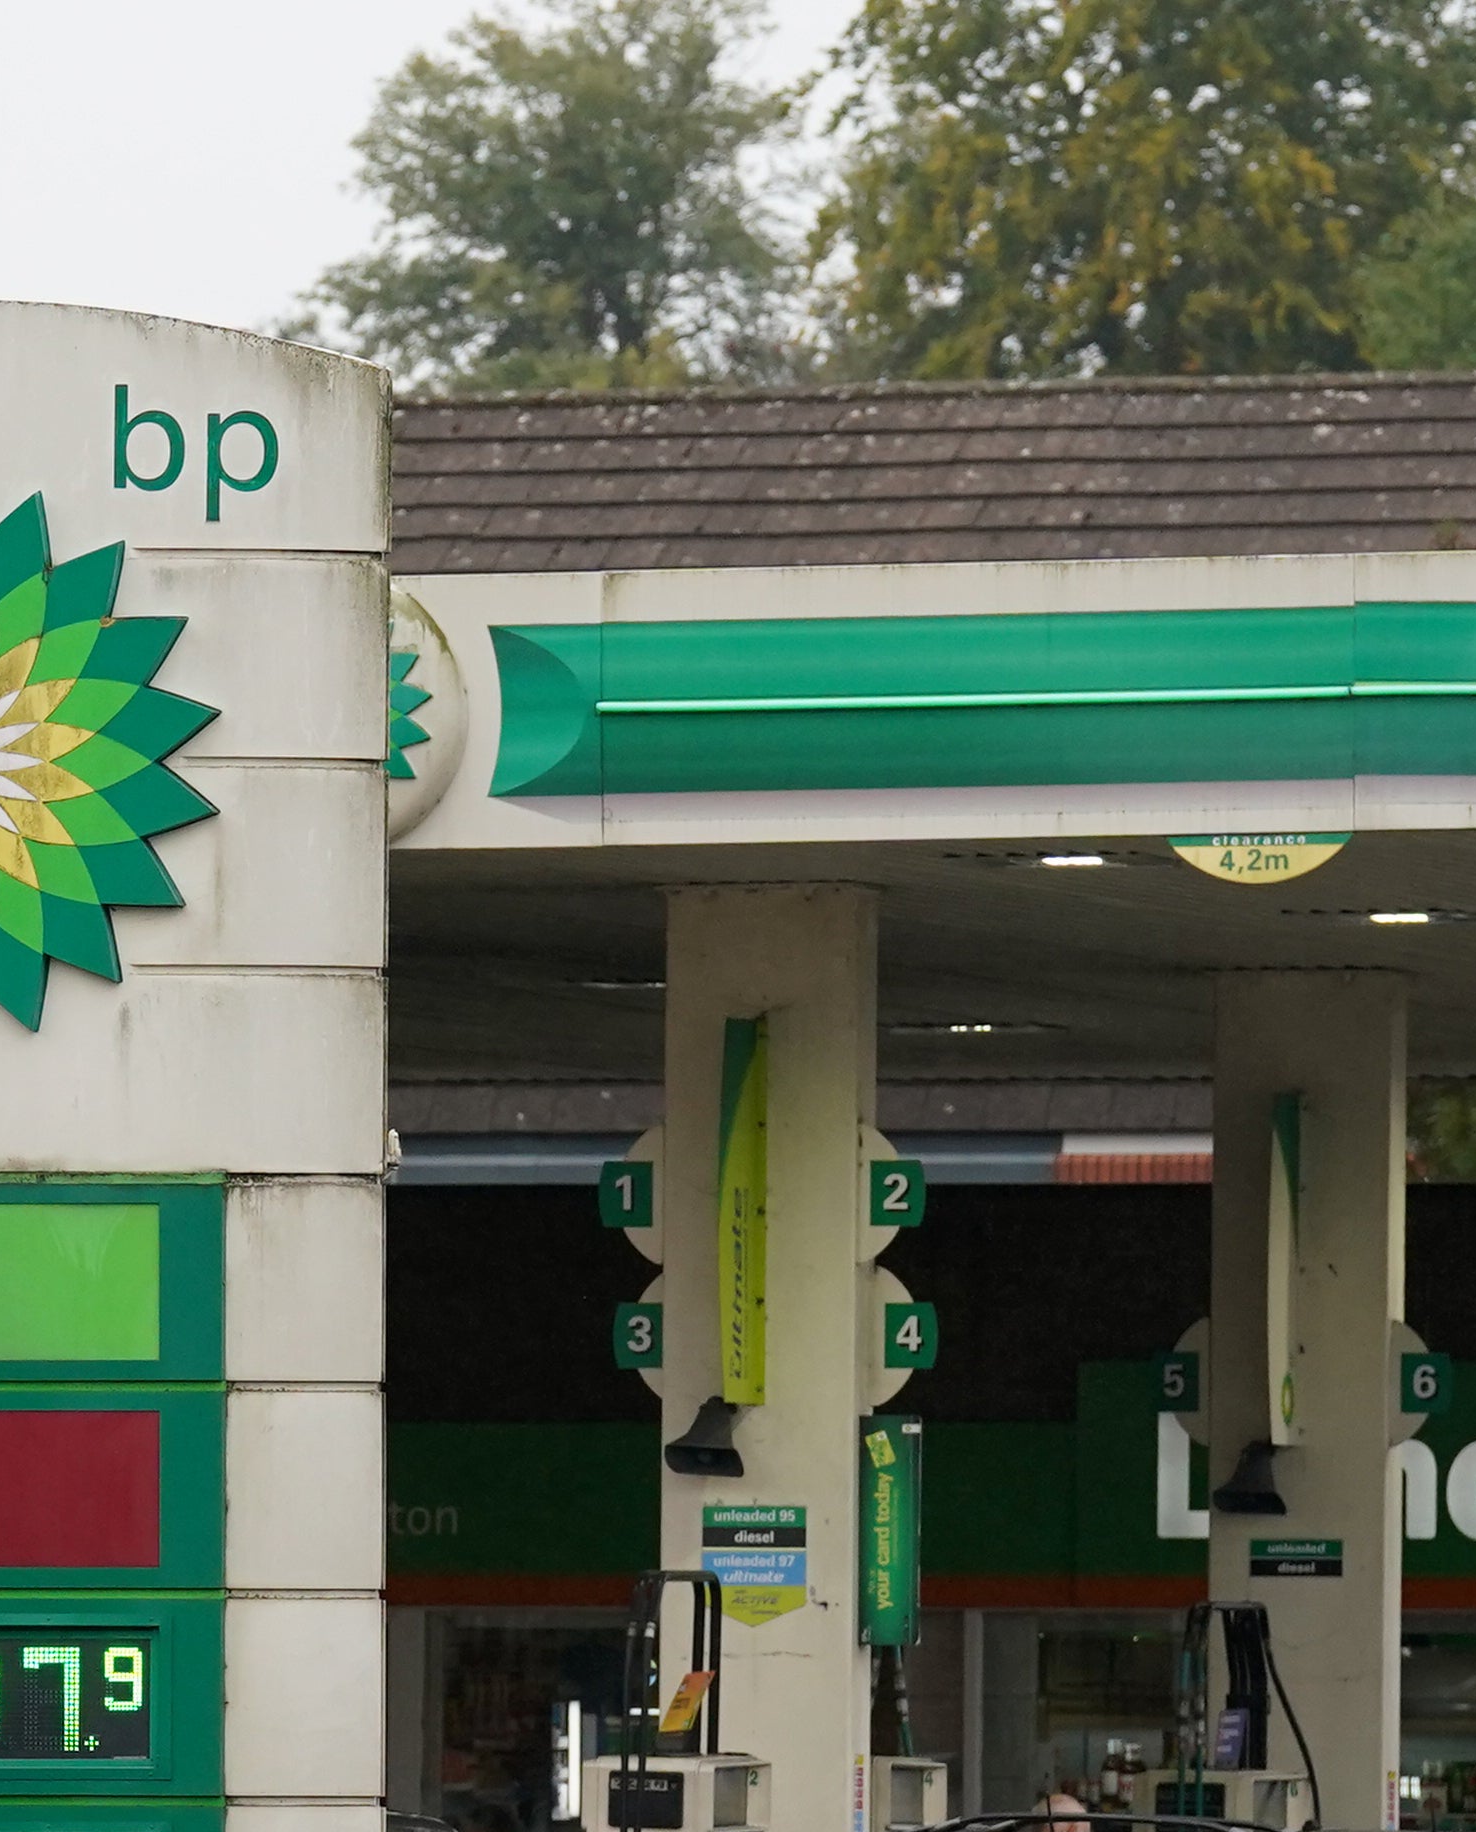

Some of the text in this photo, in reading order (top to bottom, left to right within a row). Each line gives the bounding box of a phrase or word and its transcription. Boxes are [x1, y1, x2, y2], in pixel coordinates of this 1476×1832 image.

[112, 384, 279, 522] bp
[1212, 835, 1306, 847] clearance
[614, 1175, 634, 1211] 1
[882, 1173, 910, 1211] 2
[626, 1314, 652, 1353] 3
[895, 1314, 923, 1352] 4
[1162, 1363, 1186, 1398] 5
[1412, 1365, 1438, 1400] 6
[713, 1509, 796, 1523] unleaded 95
[873, 1472, 894, 1523] today
[734, 1529, 776, 1544] diesel
[873, 1525, 891, 1566] card
[713, 1554, 777, 1567] unleaded
[876, 1569, 894, 1611] your
